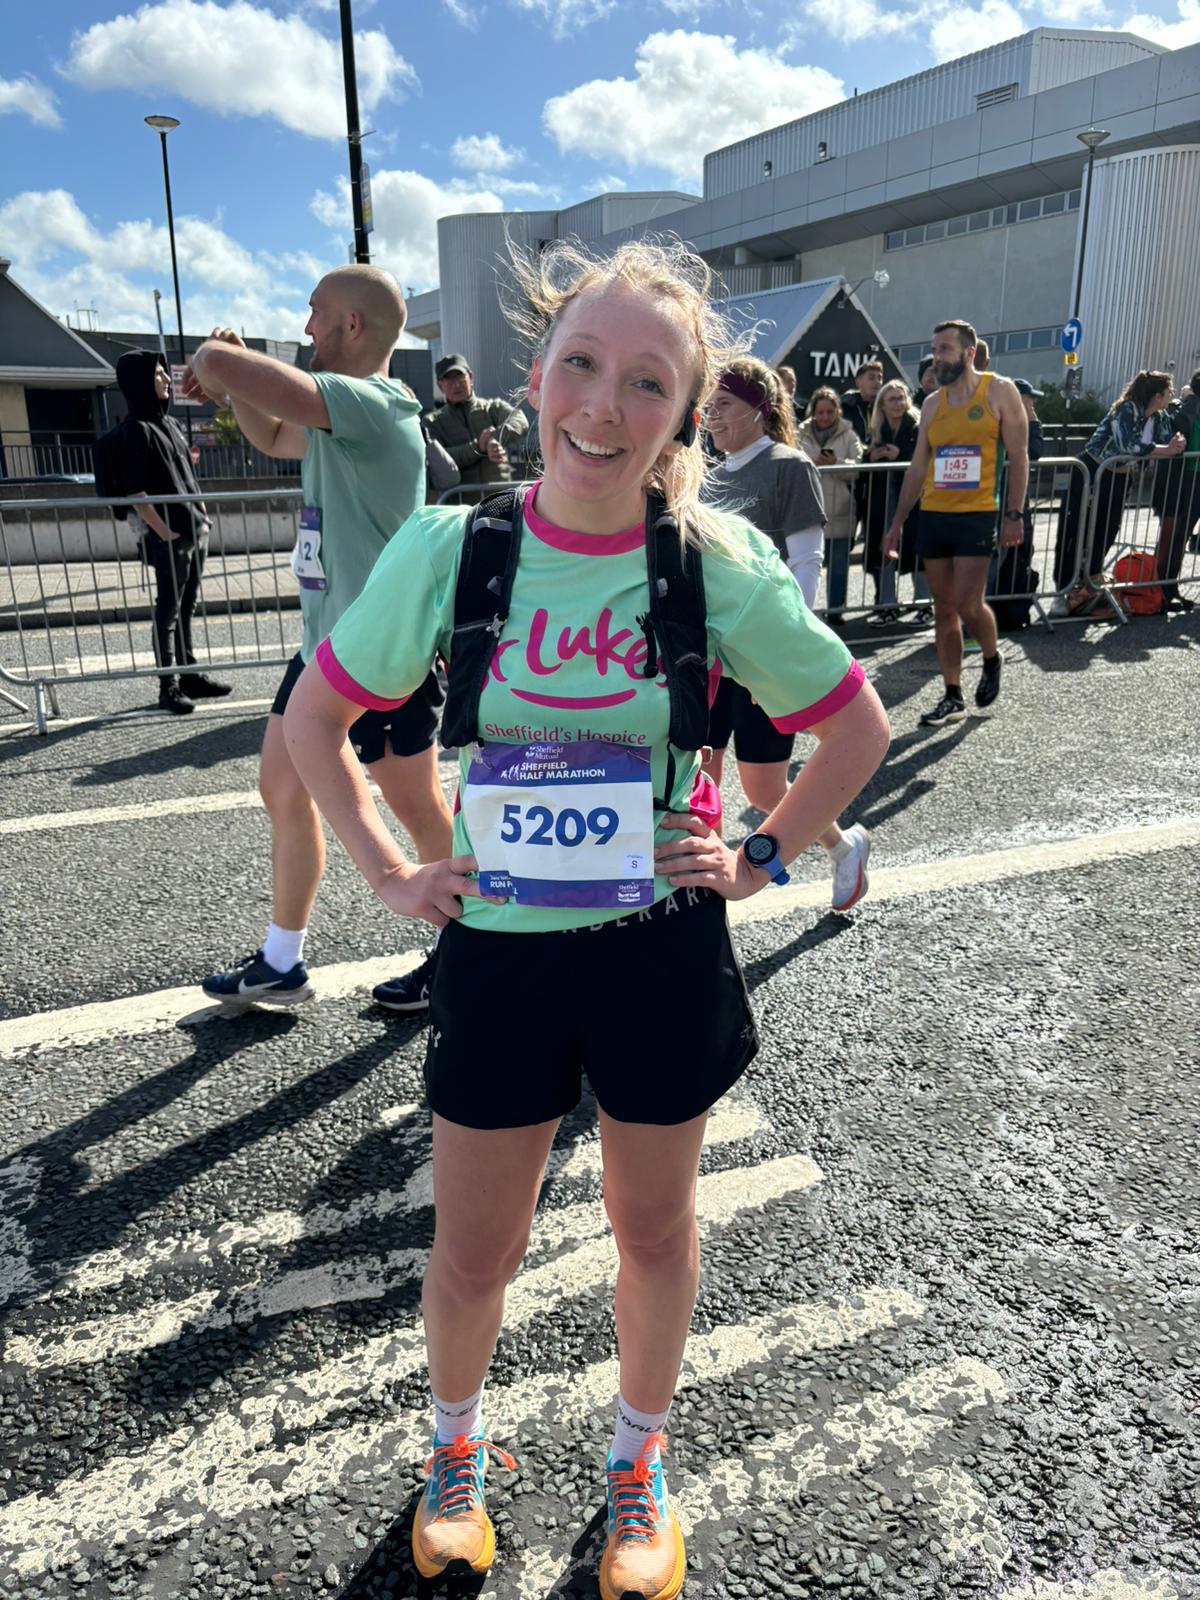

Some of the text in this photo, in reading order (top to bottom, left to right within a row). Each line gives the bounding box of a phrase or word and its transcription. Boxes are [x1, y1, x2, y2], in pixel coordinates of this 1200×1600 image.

[943, 459, 969, 471] 1:45
[943, 472, 967, 480] PACER
[526, 607, 668, 688] Luke
[484, 723, 646, 745] Sheffield's Hospice
[535, 745, 564, 753] Sheffield
[520, 761, 568, 772] SHEFFIELD
[519, 768, 606, 780] HALF MARATHON
[500, 803, 620, 848] 5209
[631, 859, 638, 869] S
[489, 880, 506, 888] RUN
